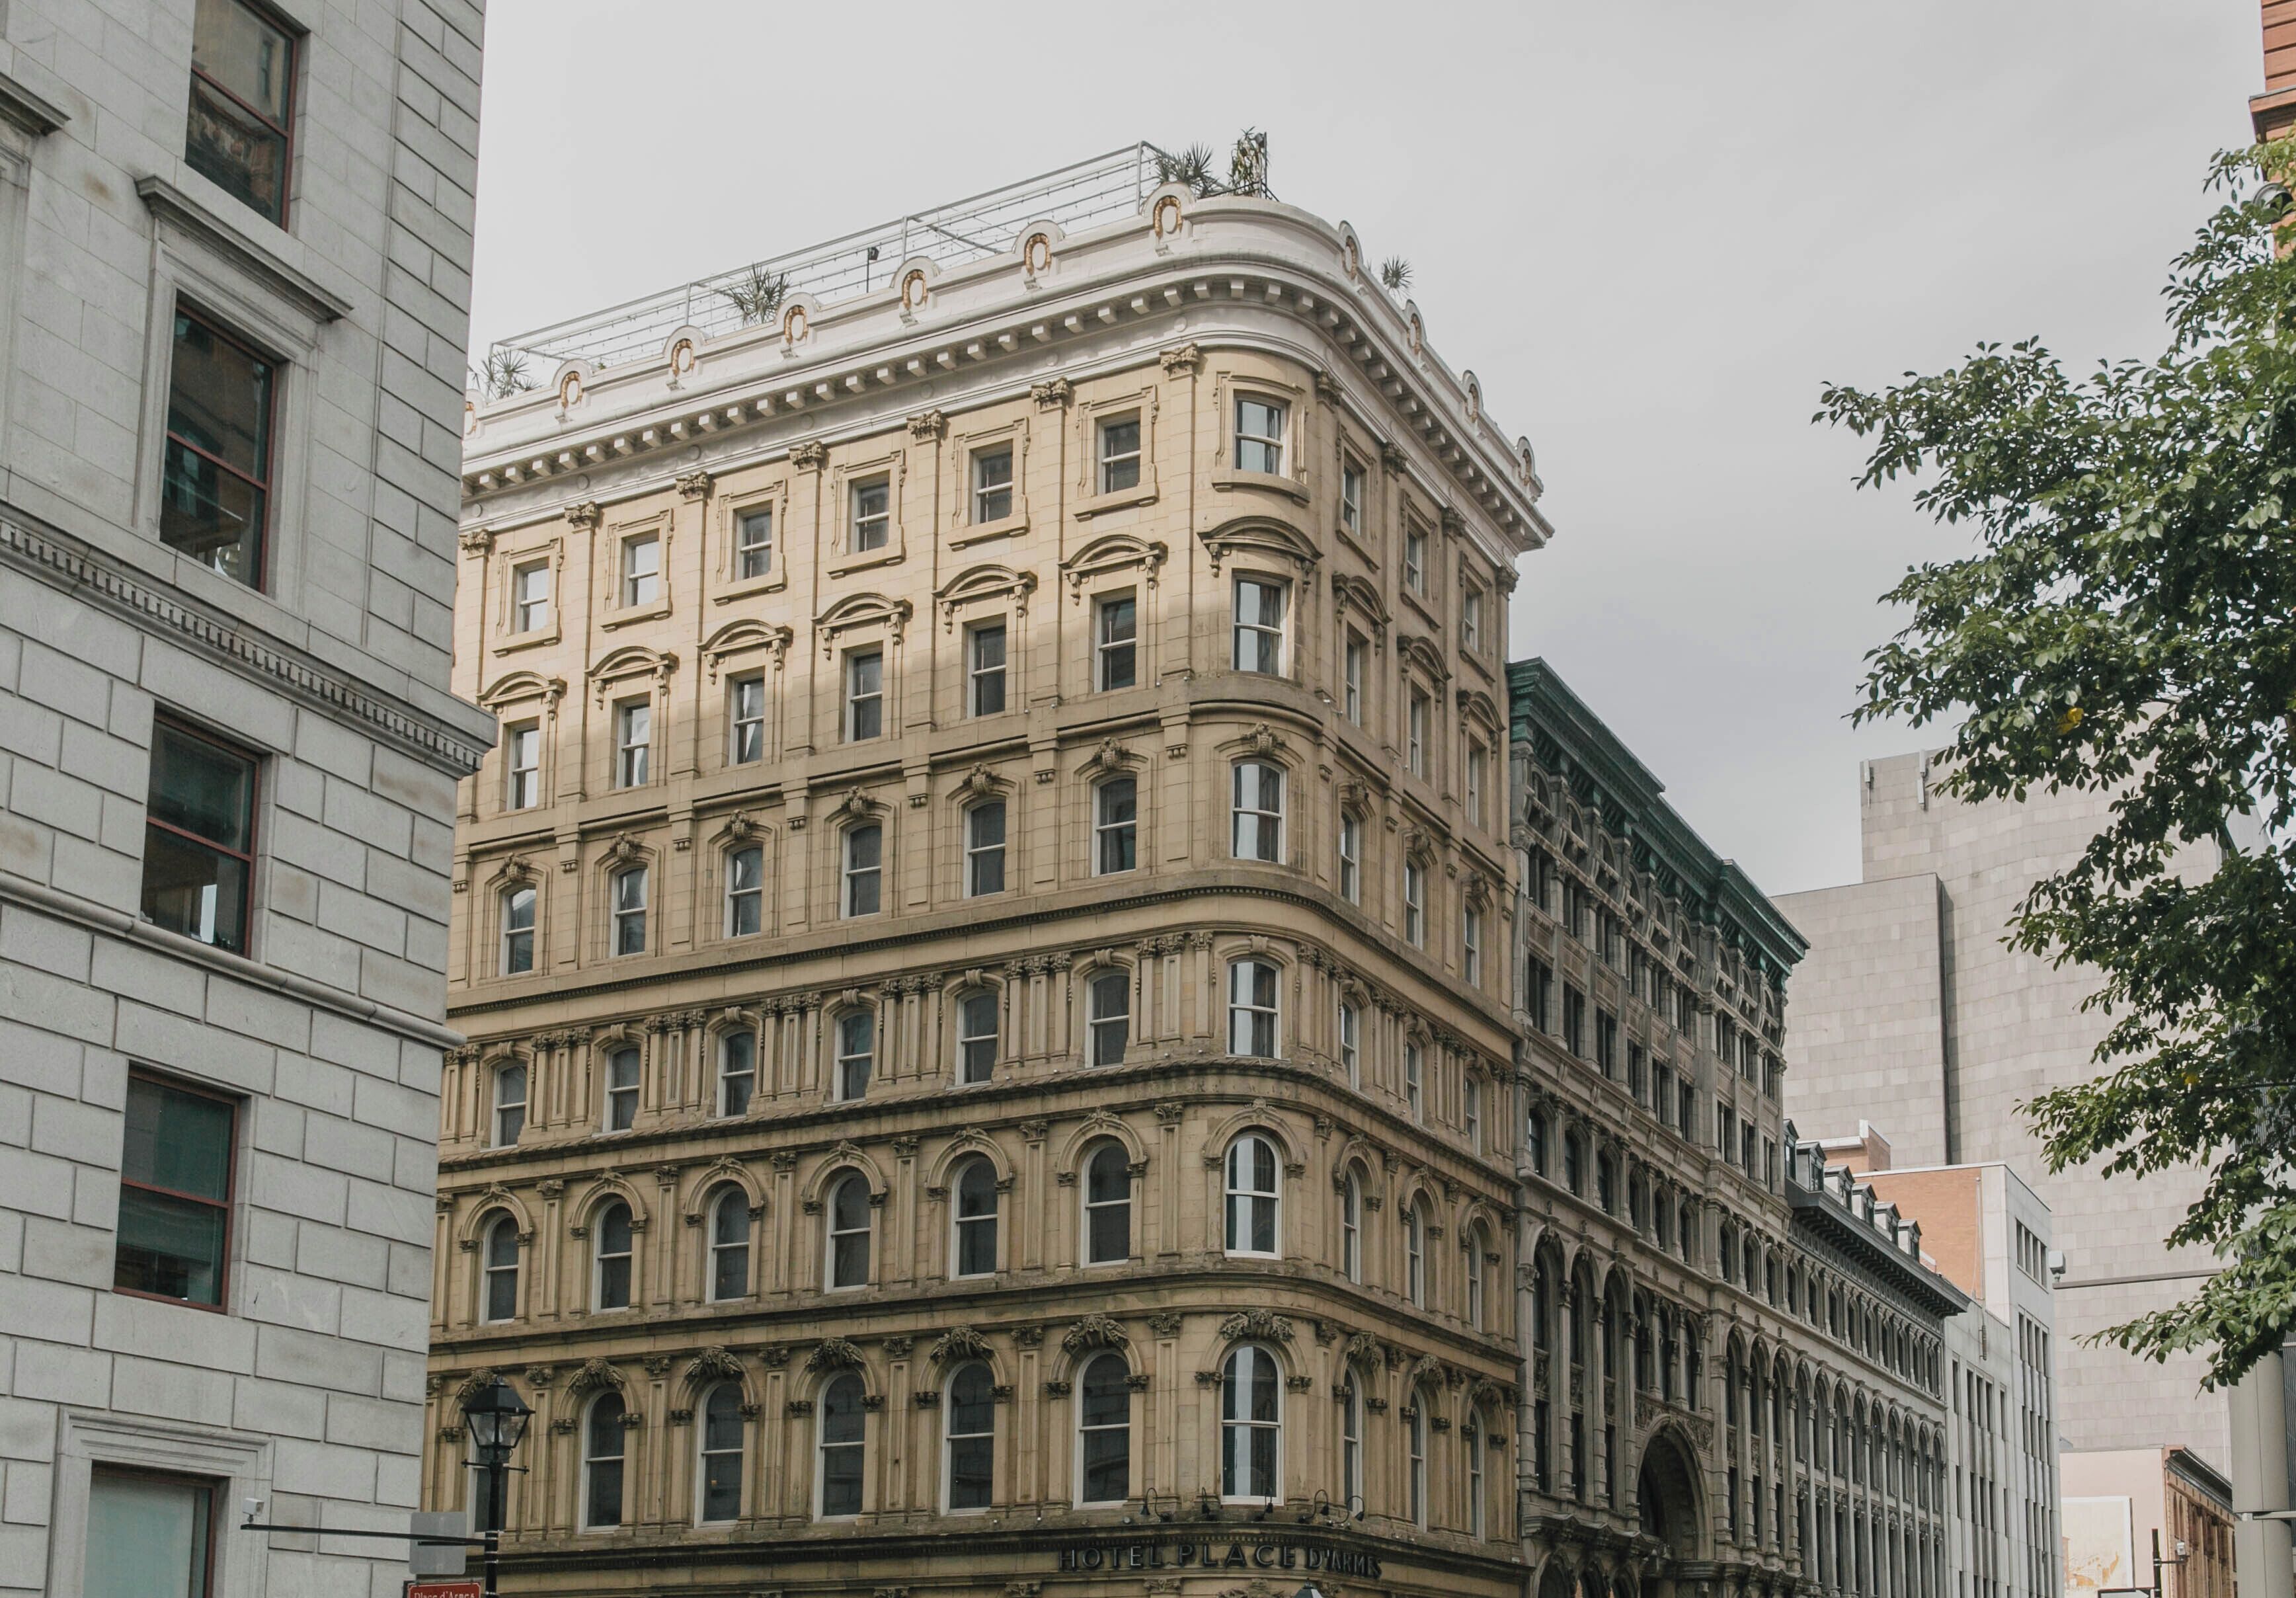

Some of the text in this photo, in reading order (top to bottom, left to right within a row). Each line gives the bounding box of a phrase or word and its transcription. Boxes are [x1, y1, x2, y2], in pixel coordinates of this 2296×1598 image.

[1058, 1543, 1382, 1578] HOTEL PLACE D'ARMES
